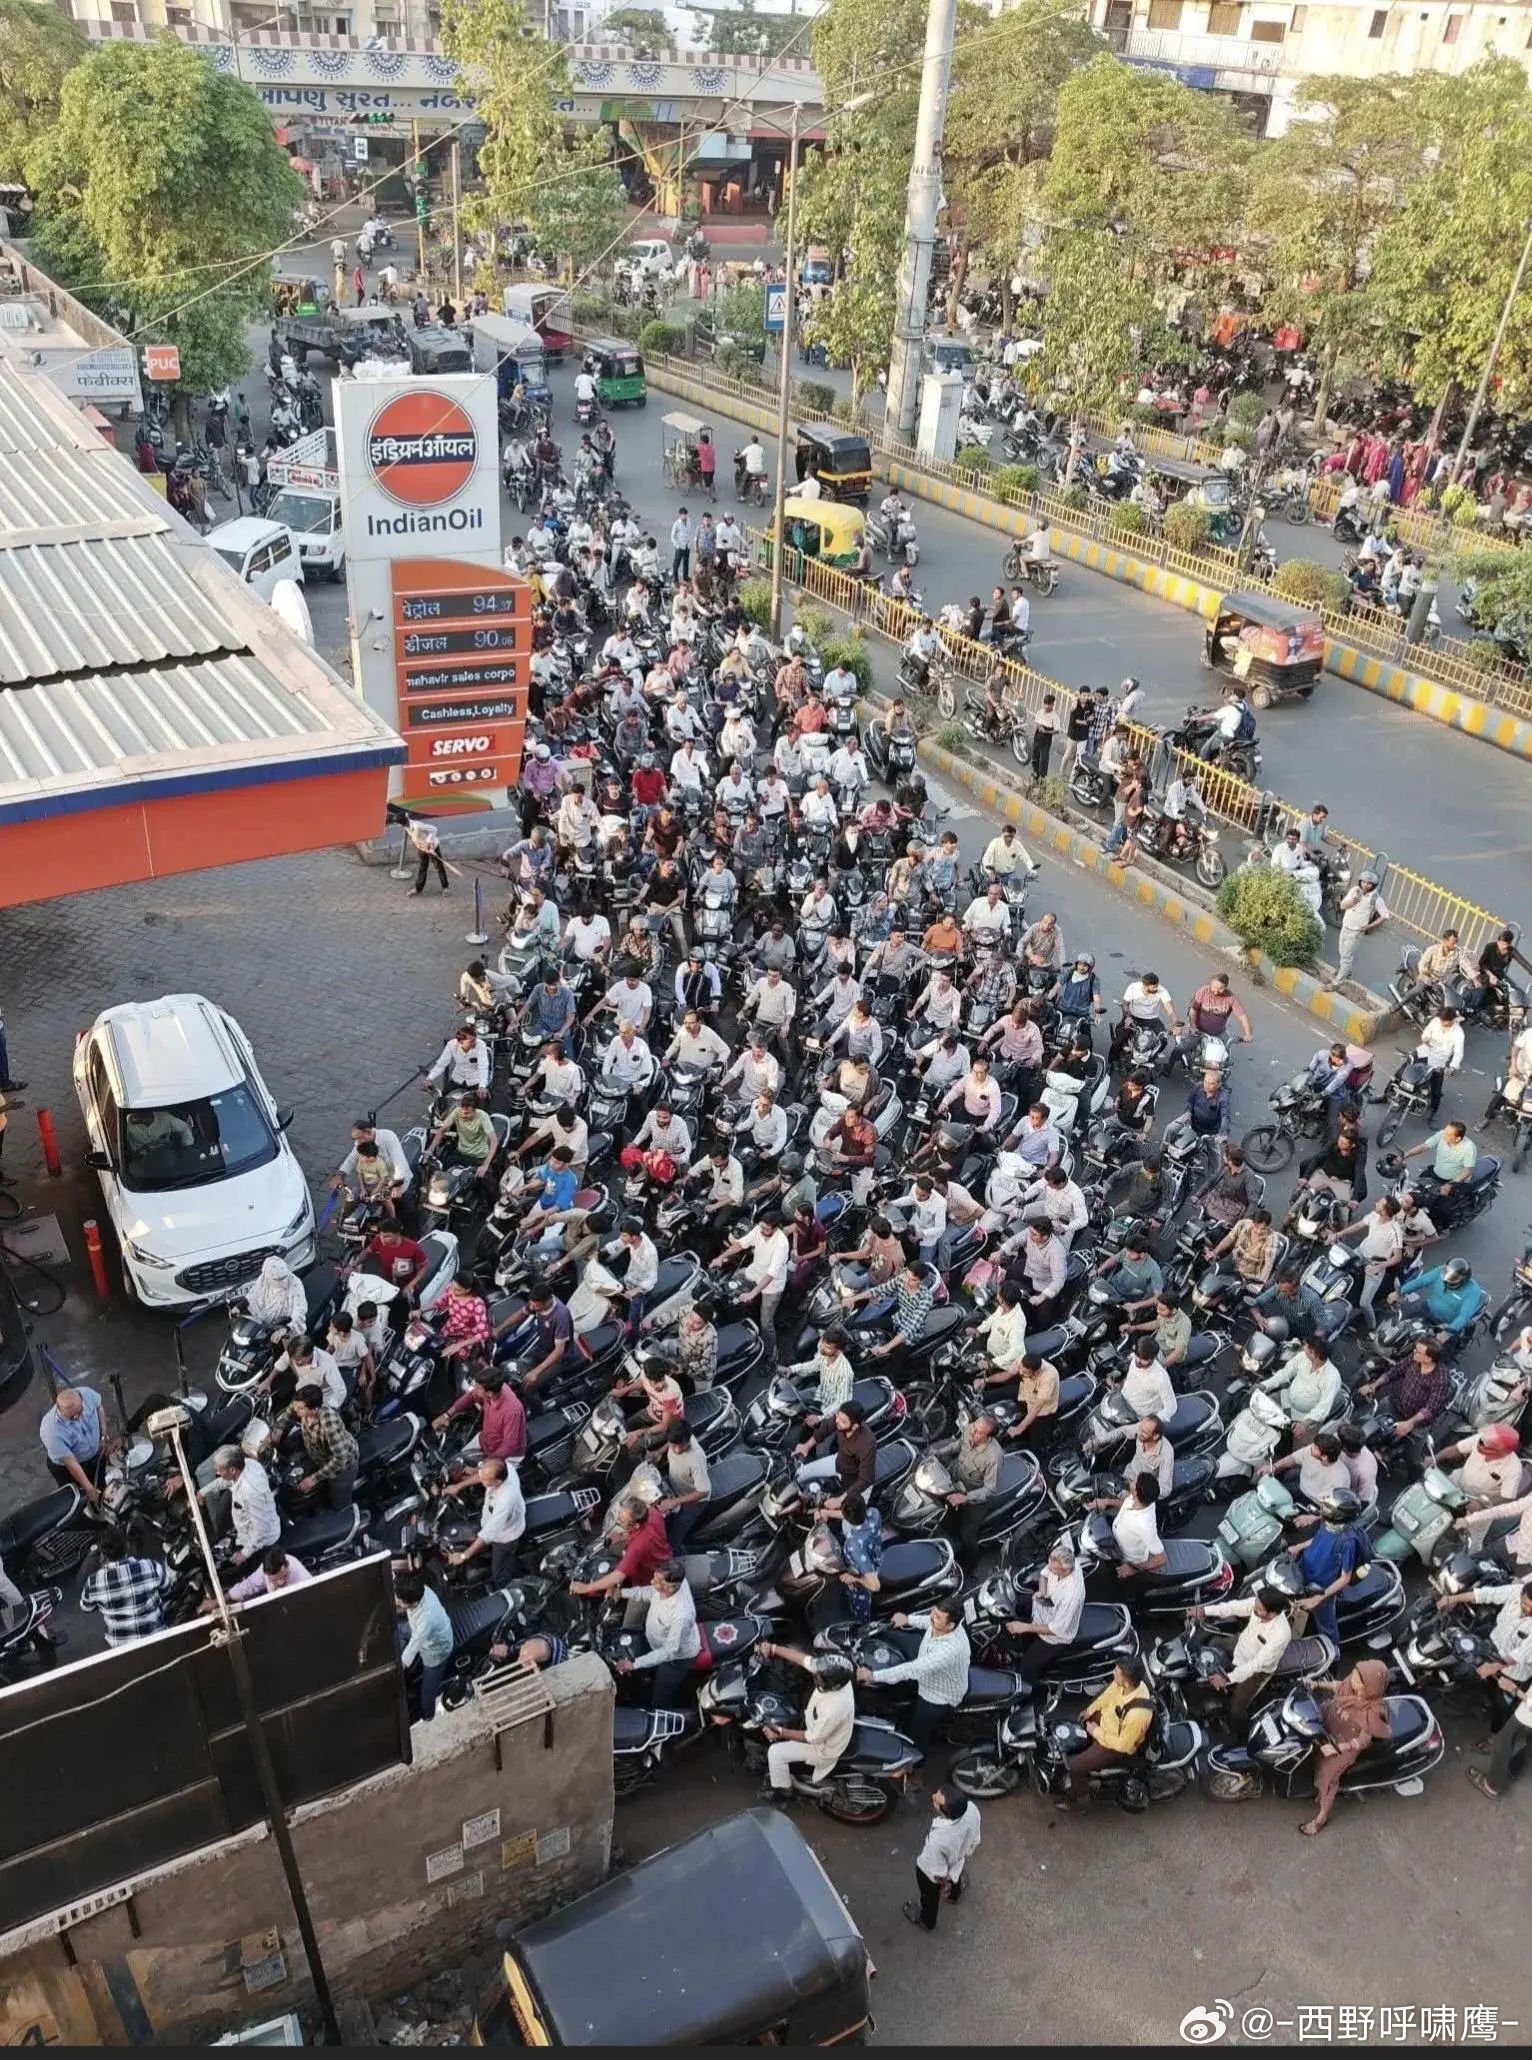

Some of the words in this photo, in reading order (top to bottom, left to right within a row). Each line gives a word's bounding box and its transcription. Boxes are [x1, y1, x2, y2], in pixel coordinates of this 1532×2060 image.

[151, 358, 178, 370] PUC
[368, 508, 482, 536] IndianOil
[405, 634, 447, 652] डीजल
[452, 671, 481, 682] sales
[484, 668, 515, 680] corpo
[432, 736, 490, 756] SERVO
